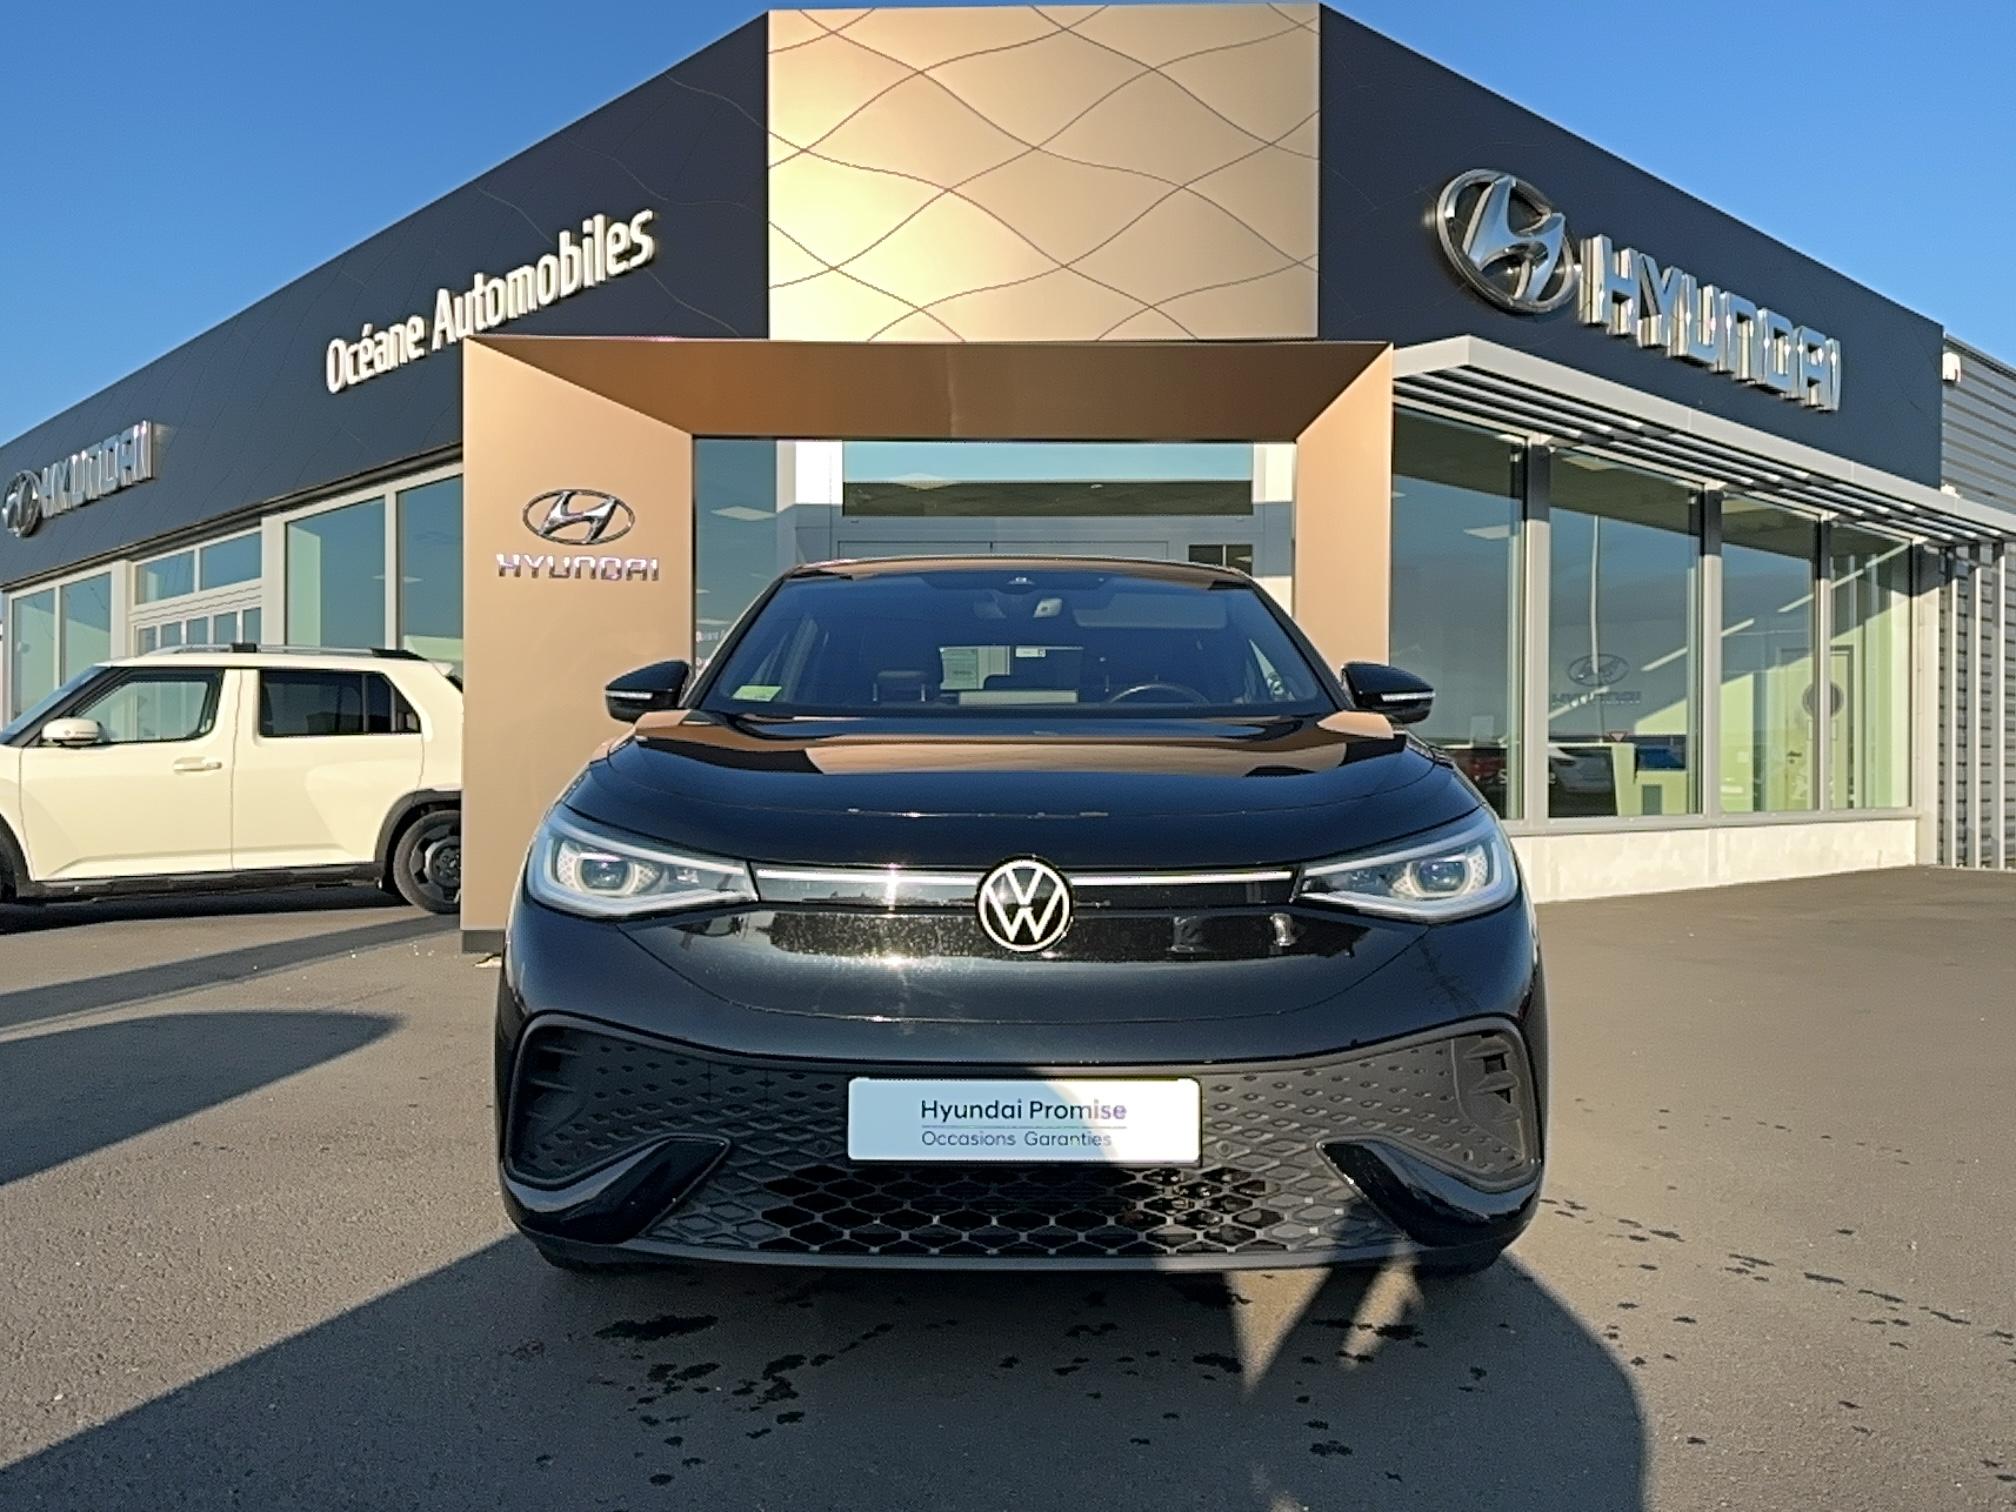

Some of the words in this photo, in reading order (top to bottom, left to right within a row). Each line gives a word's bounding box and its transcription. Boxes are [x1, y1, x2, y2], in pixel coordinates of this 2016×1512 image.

[326, 315, 425, 394] Océane
[433, 209, 656, 349] Automobiles
[1578, 234, 1841, 412] HYUNDAI
[40, 420, 152, 519] HYUNDAI
[496, 553, 660, 582] HYUNDAI
[921, 1099, 1022, 1122] Hyundai
[1029, 1099, 1127, 1120] Promise
[921, 1130, 1017, 1147] Occasions
[1024, 1129, 1112, 1147] Garanties
